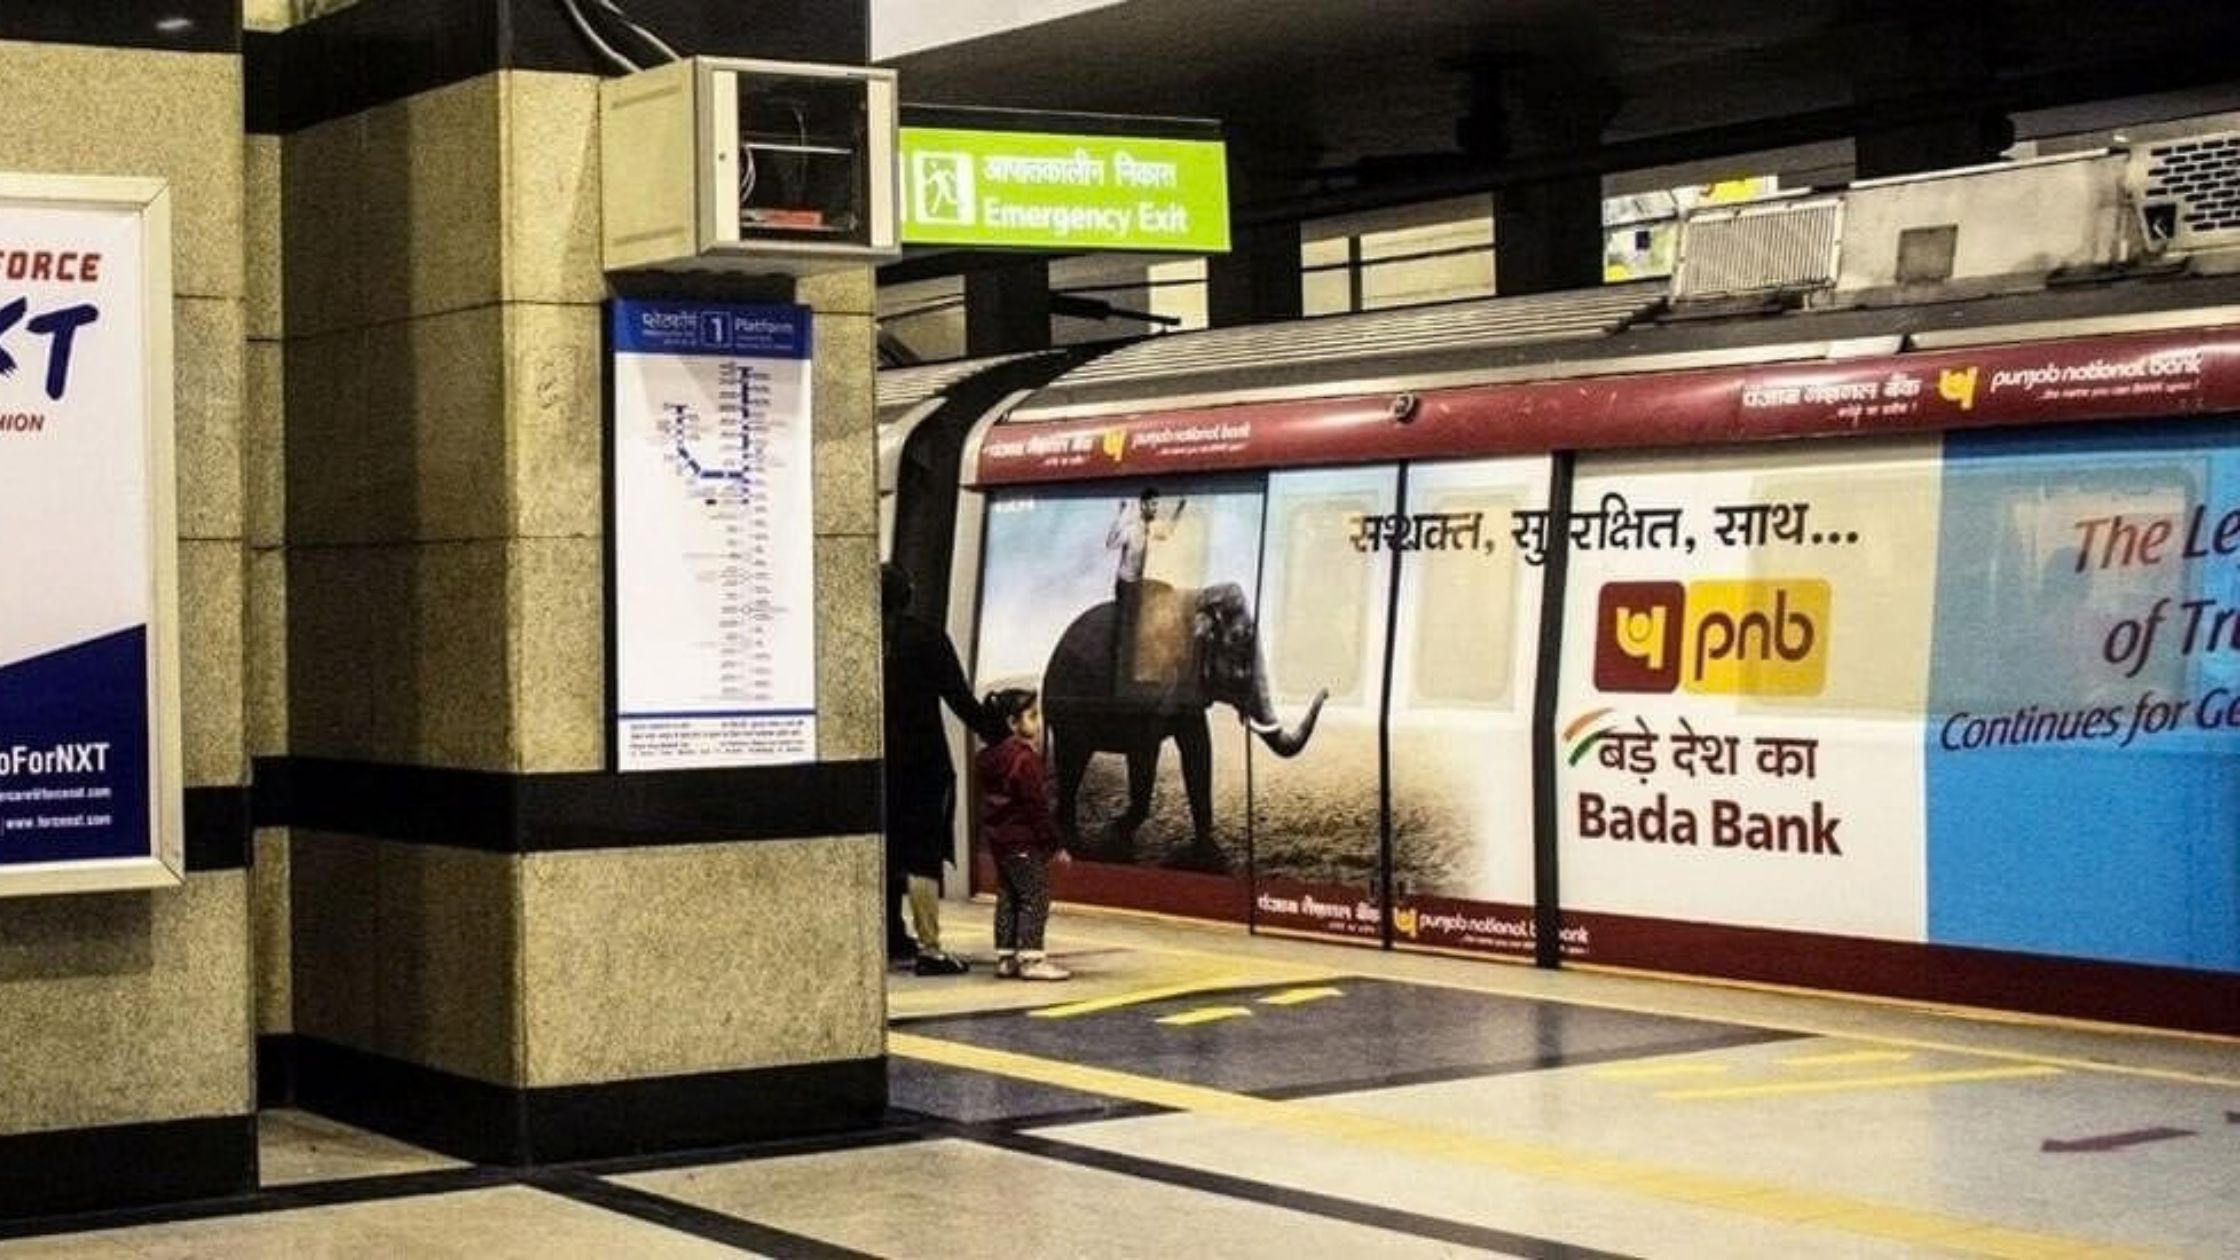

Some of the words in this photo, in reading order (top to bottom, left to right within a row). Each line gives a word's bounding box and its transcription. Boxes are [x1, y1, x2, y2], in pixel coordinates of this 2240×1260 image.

[983, 197, 1133, 237] Emergency
[1137, 201, 1190, 232] Exit
[0, 250, 102, 282] ORCE
[711, 318, 722, 342] 1
[735, 317, 793, 333] Platform
[1990, 363, 2058, 393] punjab
[2062, 359, 2144, 382] national
[2149, 352, 2202, 376] bank
[1349, 511, 1496, 555] सशक्त,
[1713, 503, 1858, 547] साथ...
[2075, 515, 2172, 573] The
[1694, 589, 1814, 681] pnb
[2104, 597, 2170, 678] of
[1940, 705, 2122, 751] Continues
[2120, 690, 2191, 748] for
[1599, 715, 1660, 784] बड़े
[1670, 716, 1740, 777] देश
[1754, 736, 1819, 778] का
[1578, 792, 1698, 846] Bada
[1711, 799, 1844, 857] Bank
[1420, 912, 1467, 934] punjab
[1469, 916, 1527, 937] national
